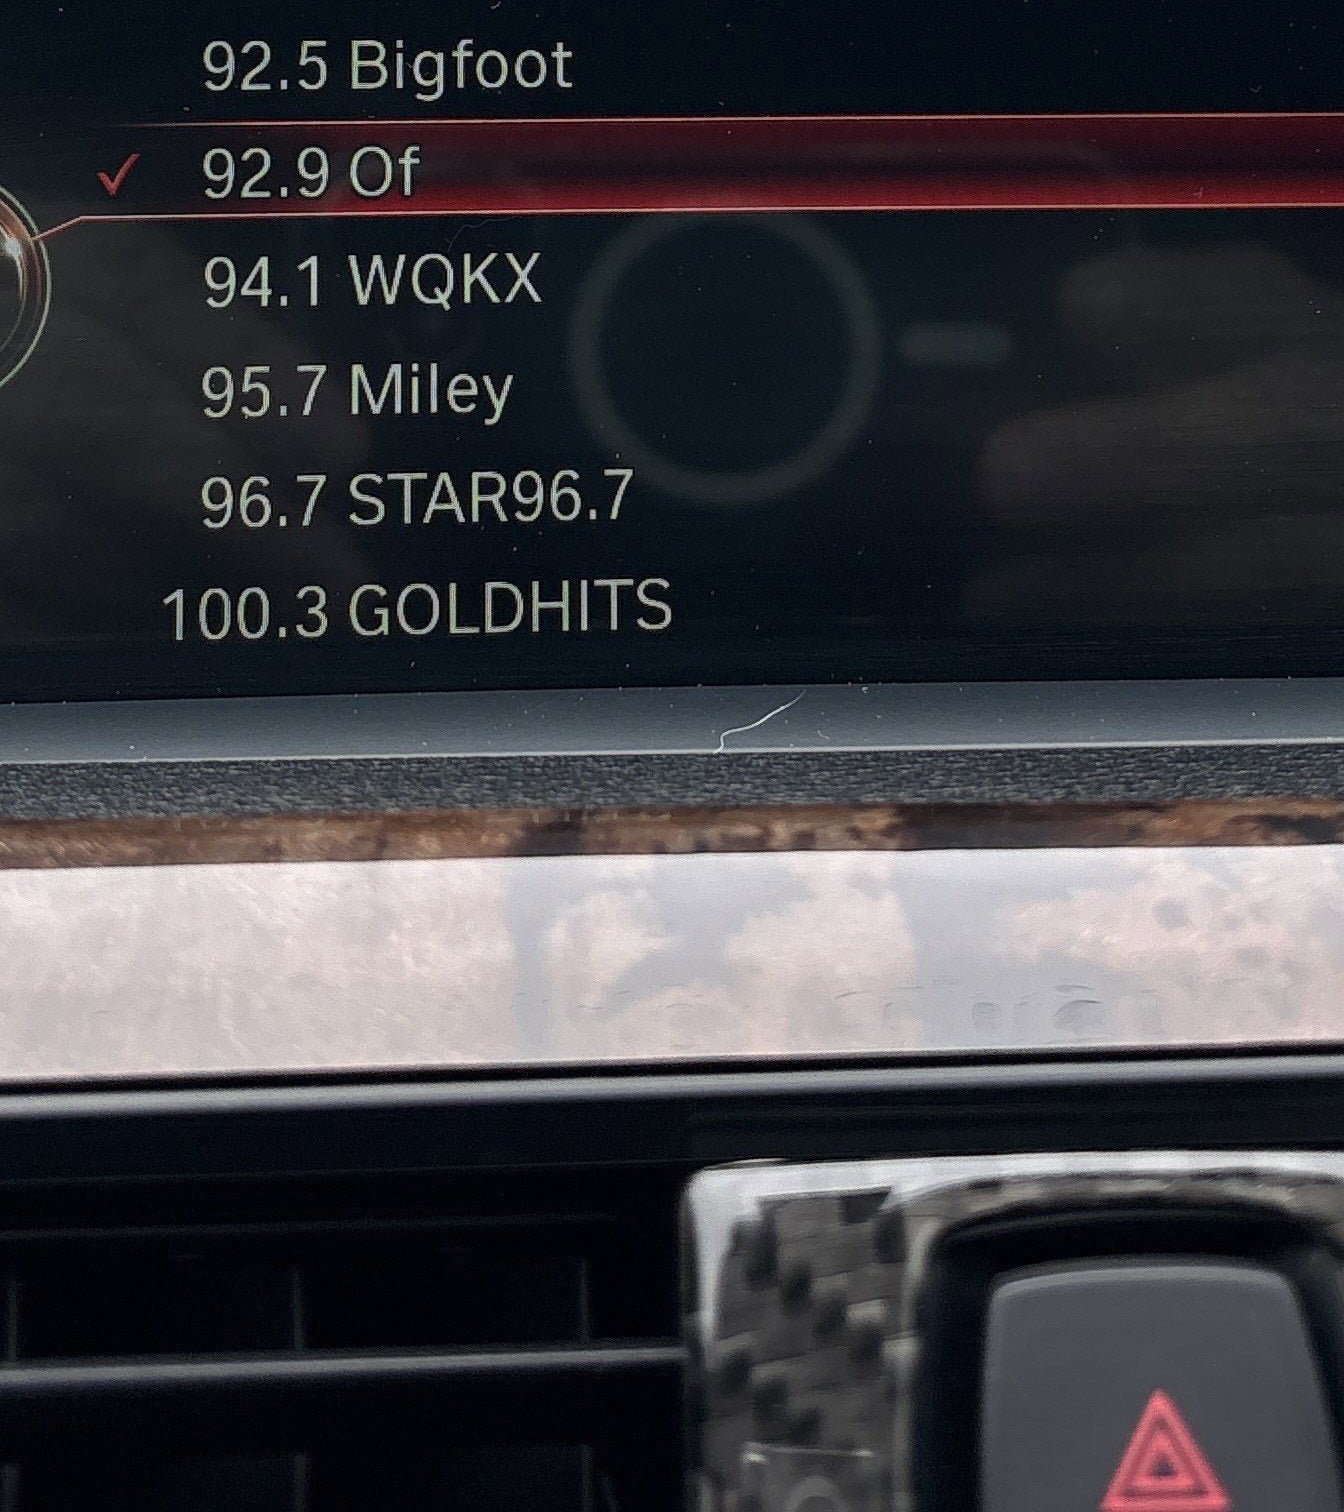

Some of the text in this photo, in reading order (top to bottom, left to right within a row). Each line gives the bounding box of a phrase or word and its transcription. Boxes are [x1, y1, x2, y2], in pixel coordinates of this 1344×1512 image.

[203, 38, 573, 102] 92.5 Bigfoot
[202, 145, 421, 199] 92.9 Of
[204, 252, 542, 311] 94.1 WQKX
[202, 362, 514, 426] 95.7 Miley
[201, 468, 634, 529] 96.7 STAR96.7
[162, 577, 672, 641] 100.3 GOLDHITS
